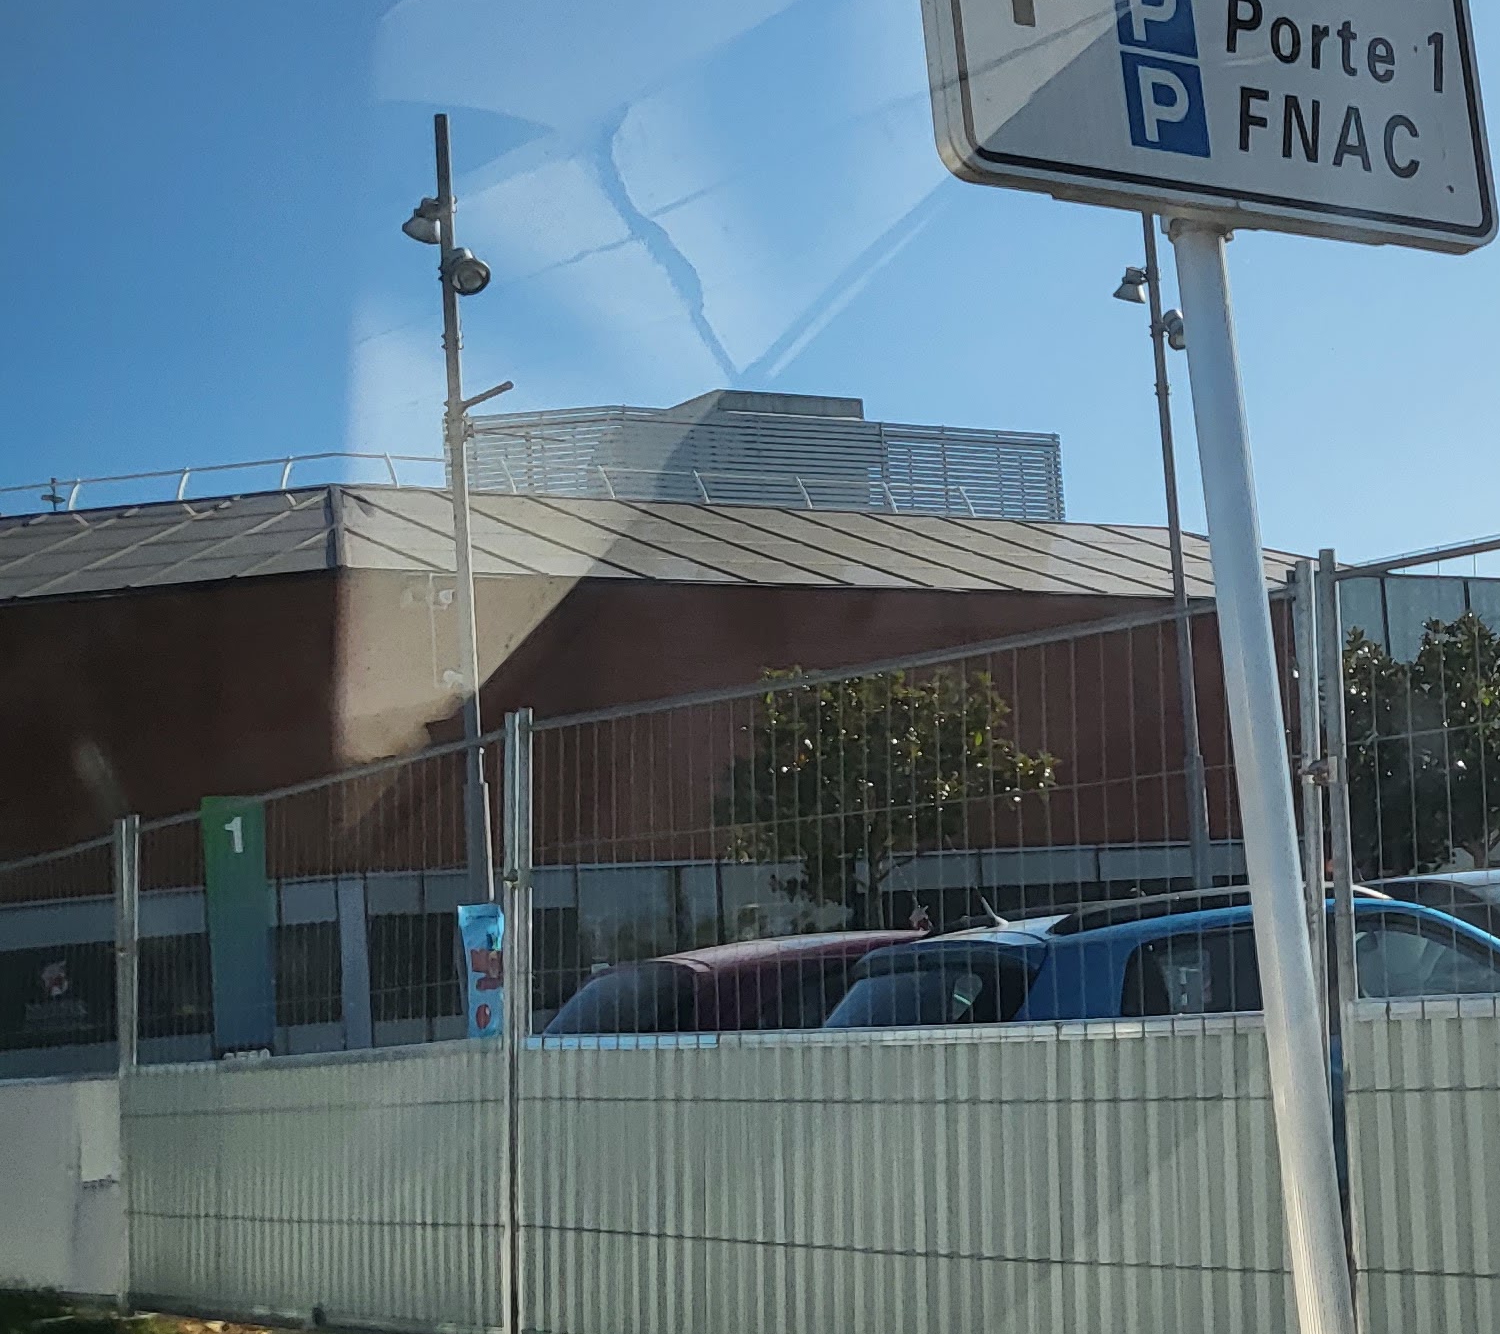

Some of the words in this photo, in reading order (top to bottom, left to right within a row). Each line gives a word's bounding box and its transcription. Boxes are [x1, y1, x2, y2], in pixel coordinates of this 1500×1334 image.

[1427, 32, 1444, 93] 1
[1137, 66, 1189, 143] P
[1238, 85, 1421, 179] FNAC
[224, 816, 243, 854] 1
